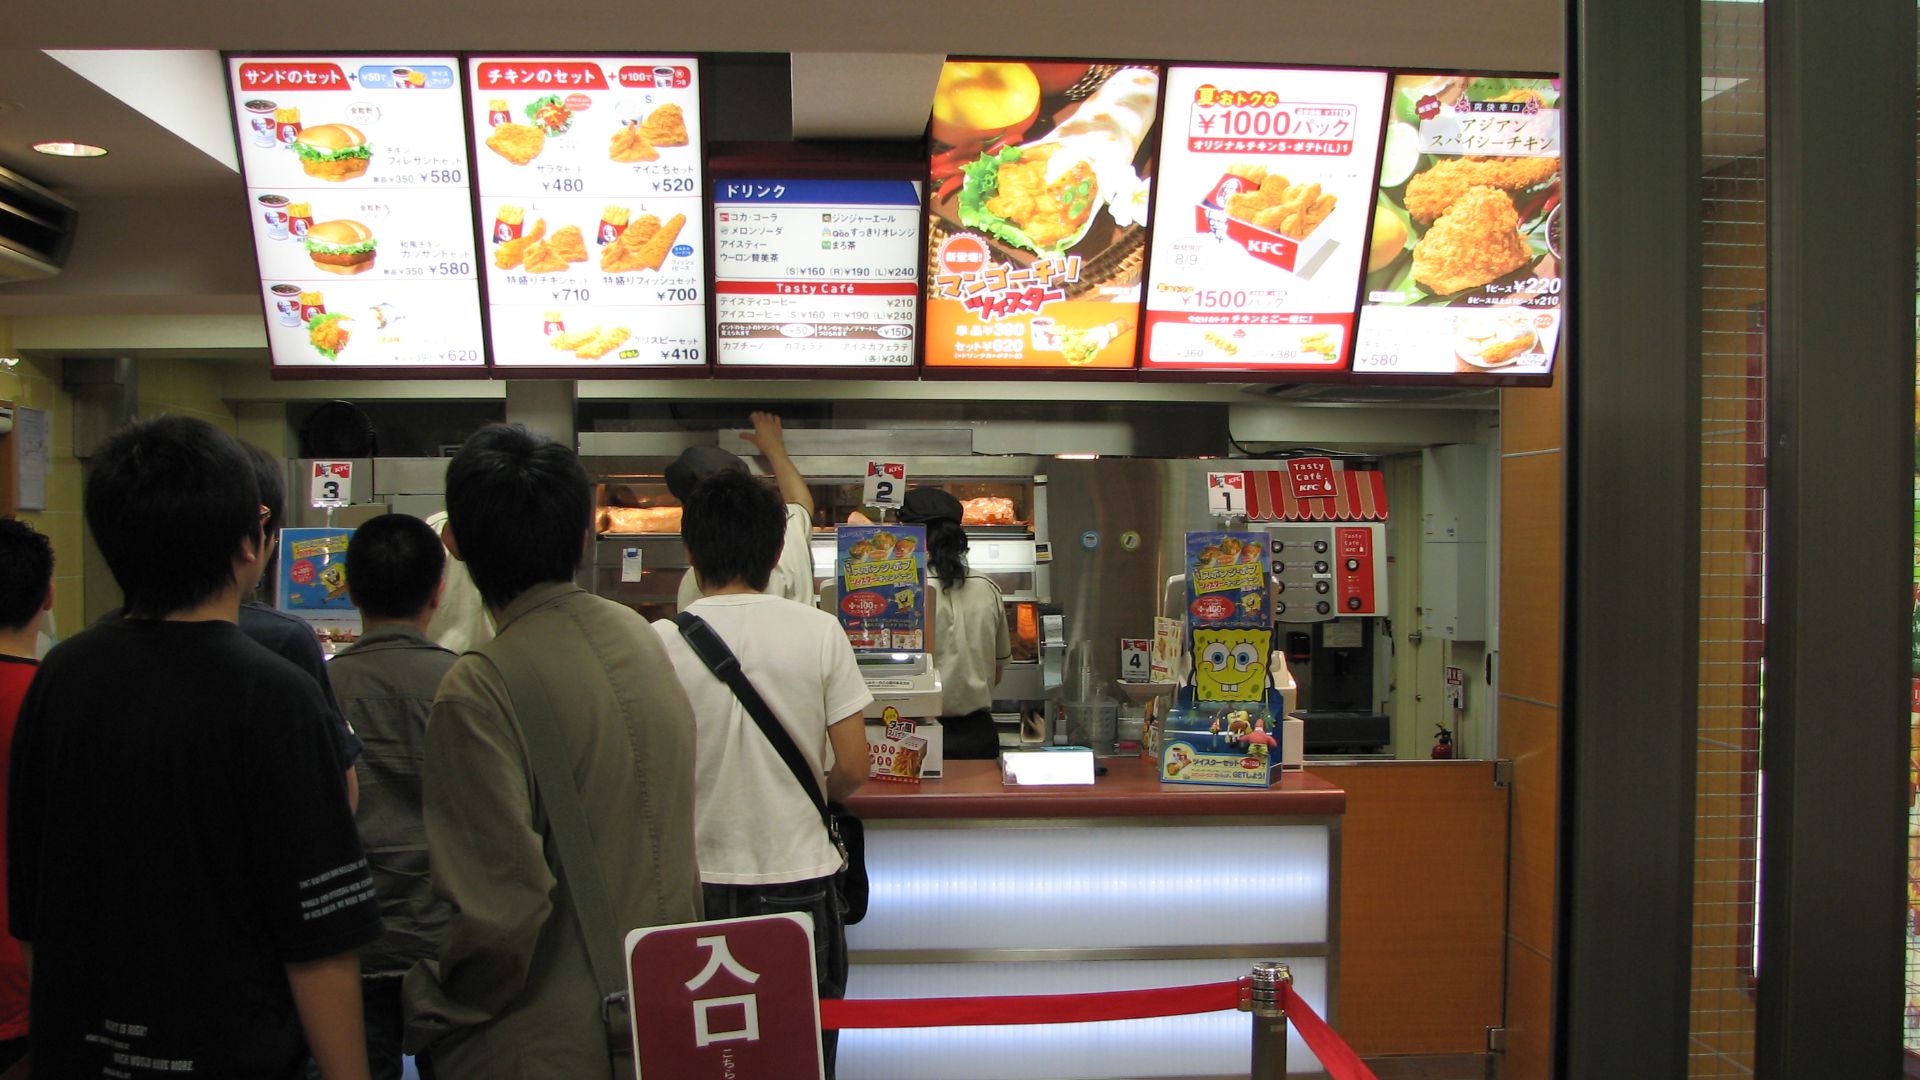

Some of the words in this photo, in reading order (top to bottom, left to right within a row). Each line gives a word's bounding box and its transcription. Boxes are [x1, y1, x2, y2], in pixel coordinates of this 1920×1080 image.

[245, 69, 341, 85] サンドのセット
[488, 69, 595, 84] チキンのセット
[645, 95, 652, 104] S
[1462, 117, 1528, 133] アジアン
[1430, 134, 1553, 151] スパイシーチキン
[420, 169, 462, 183] ¥580
[543, 179, 584, 192] ¥480
[652, 178, 694, 191] ¥520
[727, 184, 786, 199] ドリンク
[641, 203, 647, 211] L
[731, 213, 778, 222] コカ・コーラ
[832, 215, 896, 223] ジンジャーエール
[731, 226, 783, 235] メロンソーダ
[720, 240, 767, 249] アイスティー
[832, 241, 856, 249] まろ茶
[1247, 240, 1284, 256] KFC
[429, 262, 470, 275] ¥580
[786, 267, 825, 276] (S)¥160
[830, 267, 870, 277] (R)¥190
[874, 268, 914, 277] (L)¥240
[937, 256, 1080, 297] マンゴーチリ
[776, 283, 817, 295] Tasty
[821, 283, 855, 294] Café
[1513, 277, 1561, 294] ¥220
[552, 289, 590, 301] ¥710
[656, 288, 697, 301] ¥700
[720, 297, 797, 306] テイスティコーヒー
[887, 299, 913, 308] ¥210
[964, 287, 1065, 321] ツイスター
[720, 310, 781, 319] アイスコーヒー
[438, 350, 478, 362] ¥620
[660, 348, 699, 360] ¥410
[1360, 354, 1398, 366] ¥580
[335, 464, 349, 473] KFC
[888, 465, 903, 473] KFC
[1293, 463, 1325, 471] Tasty
[1228, 475, 1241, 484] KFC
[323, 481, 339, 501] 3
[876, 481, 893, 503] 2
[1299, 484, 1320, 492] KFC
[1222, 492, 1231, 511] 1
[1129, 653, 1142, 669] 4
[684, 934, 761, 1048] 入口
